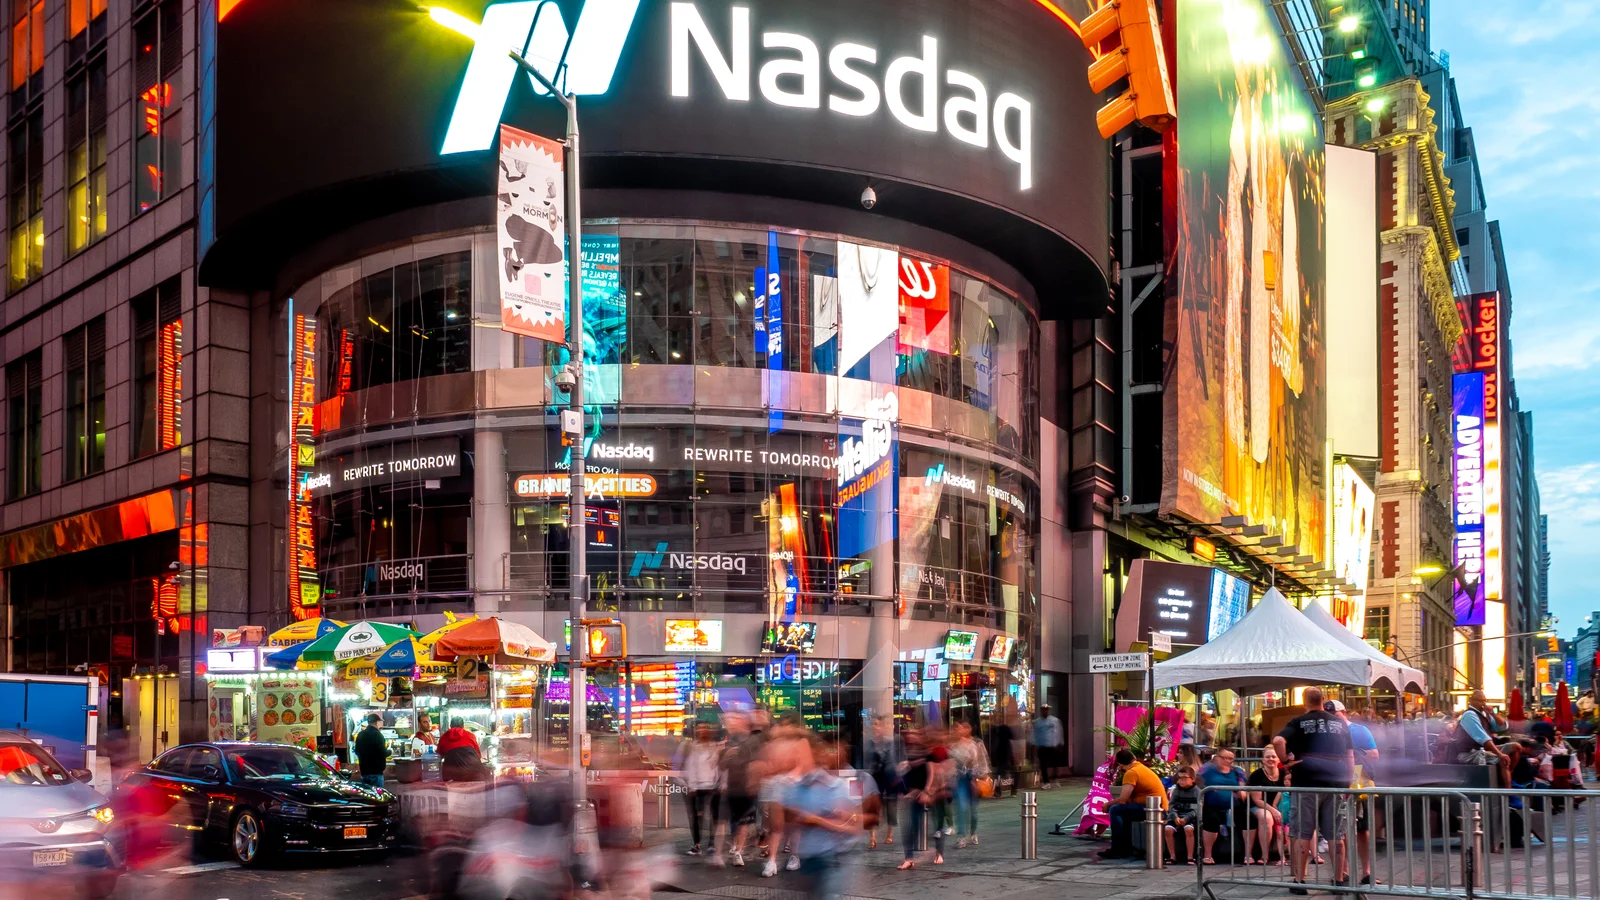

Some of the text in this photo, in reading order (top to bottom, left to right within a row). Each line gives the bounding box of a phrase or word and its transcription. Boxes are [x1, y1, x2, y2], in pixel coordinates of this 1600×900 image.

[667, 0, 1033, 191] Nasdaq
[1474, 296, 1497, 369] Locker
[592, 442, 654, 462] Nasdaq
[684, 447, 753, 463] REWRITE
[343, 454, 456, 481] REWRITE TOMORROW
[1456, 414, 1481, 526] ADVERTISE
[599, 477, 652, 493] CITIES
[942, 470, 976, 494] Nasdaq
[380, 561, 424, 581] Nasdaq
[669, 552, 747, 576] Nasdaq
[339, 650, 352, 659] KEEP
[352, 648, 367, 657] PARK
[1091, 655, 1117, 663] PEDESTRIAN
[419, 664, 459, 674] SABRET
